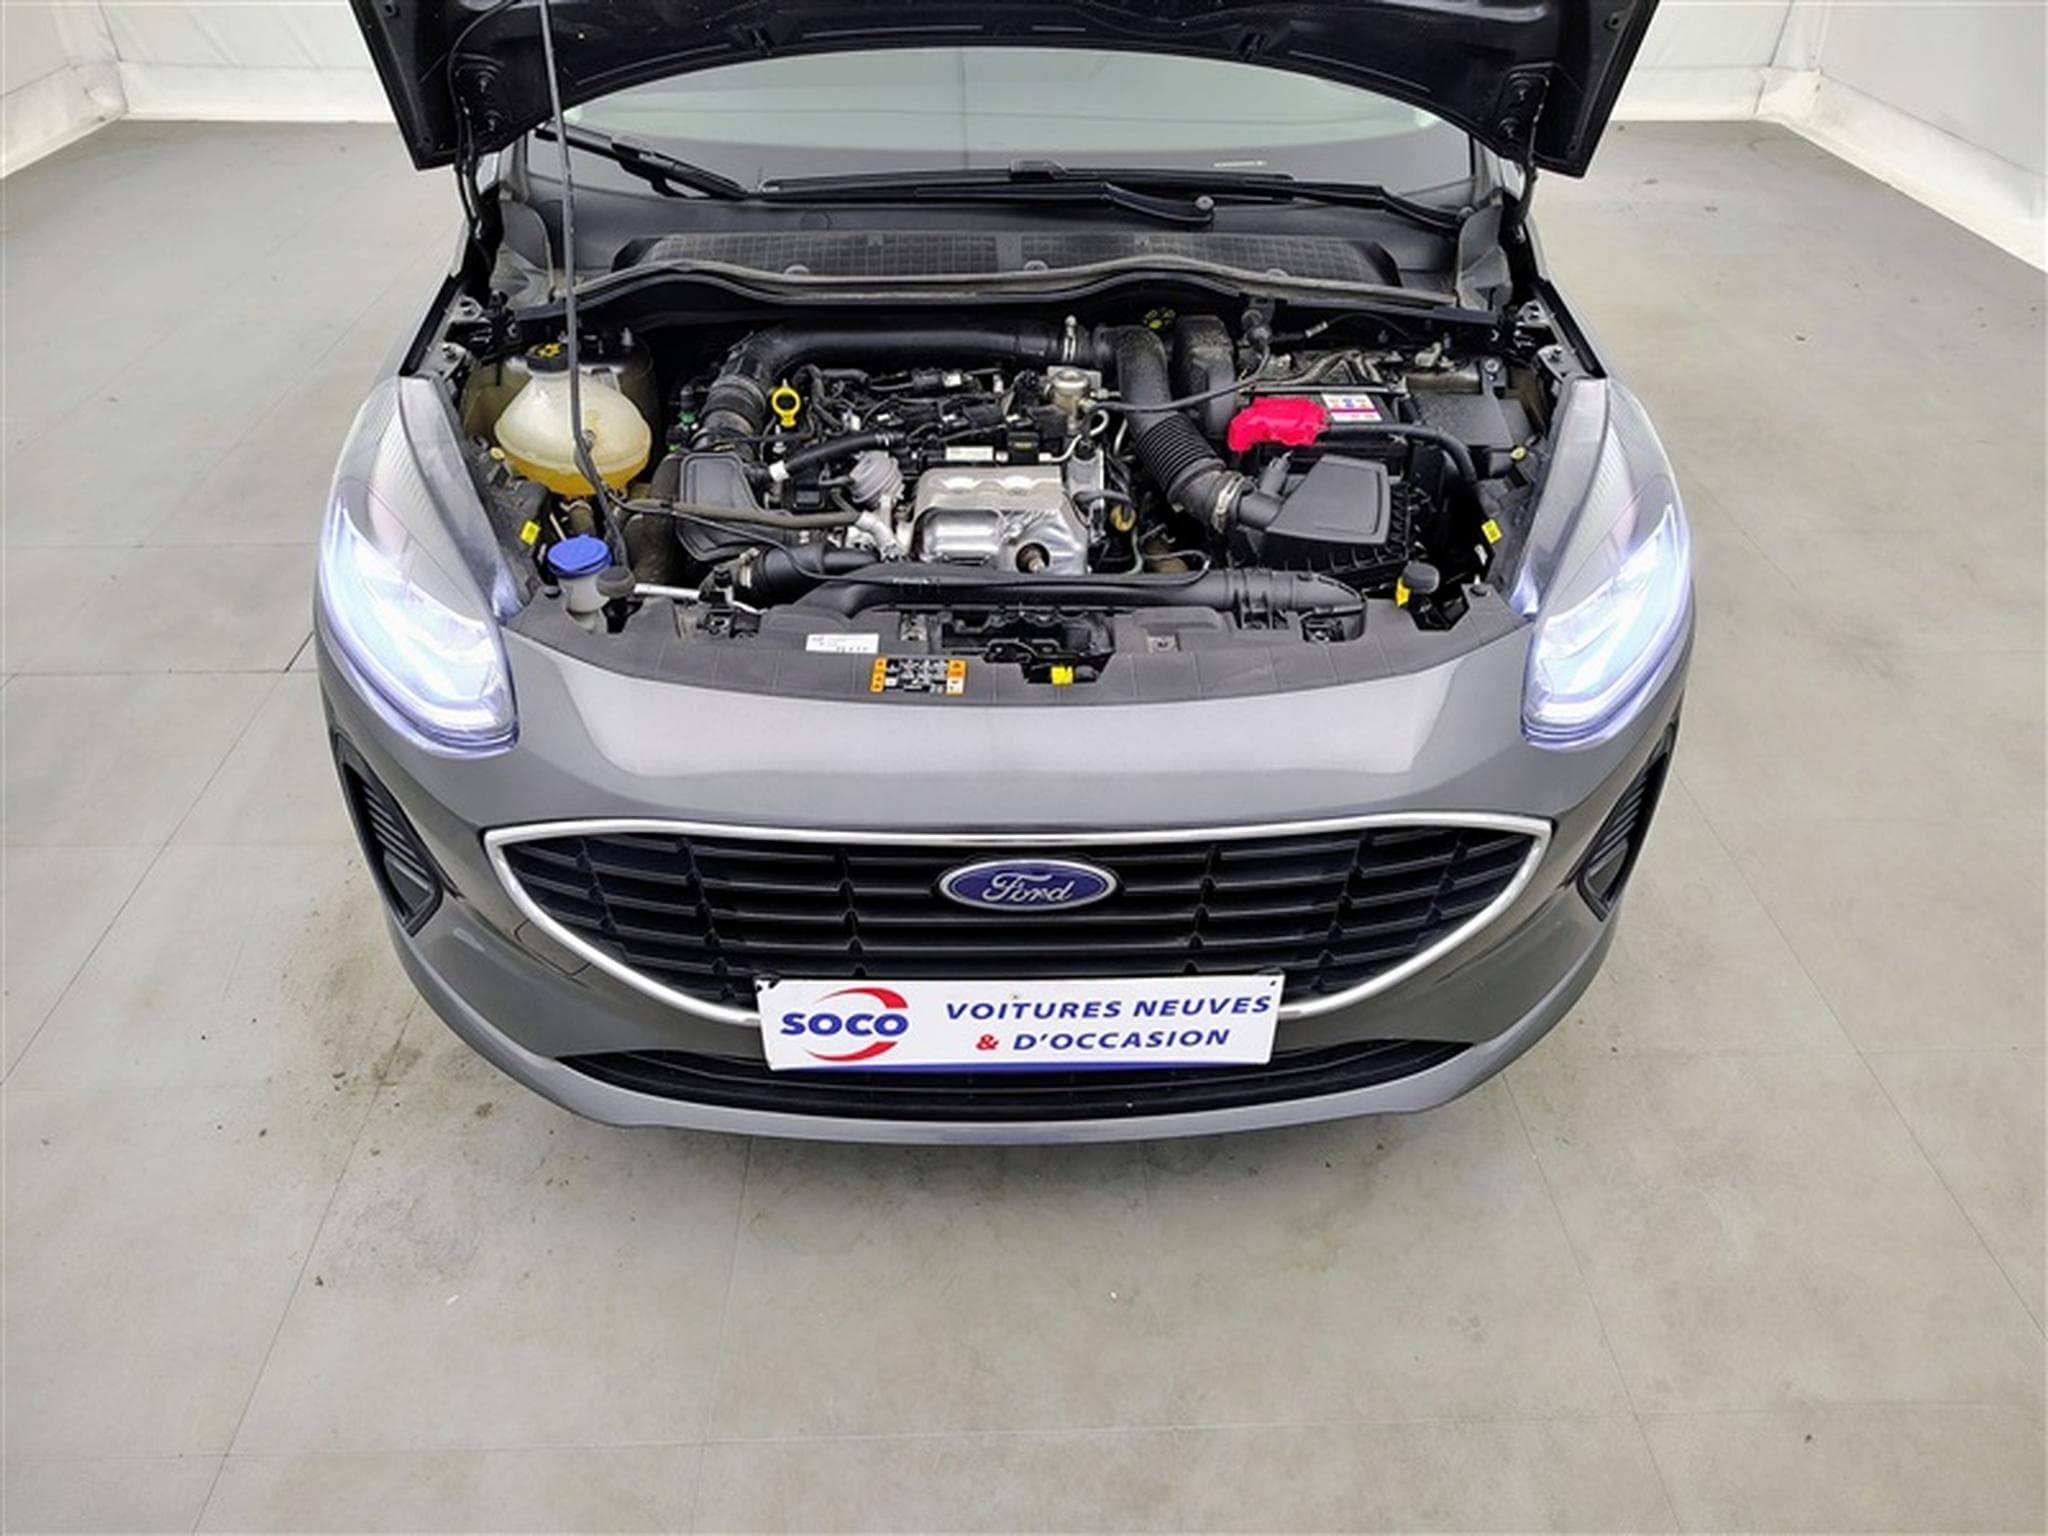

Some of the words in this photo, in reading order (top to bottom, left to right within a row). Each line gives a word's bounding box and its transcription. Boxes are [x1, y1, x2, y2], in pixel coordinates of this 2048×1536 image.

[982, 872, 1075, 902] Ford
[945, 1000, 1122, 1021] VOITURES
[1132, 995, 1272, 1018] NEUVES
[780, 1012, 909, 1037] SOCO
[975, 1033, 1000, 1051] &
[1013, 1028, 1230, 1051] D'OCCASION
